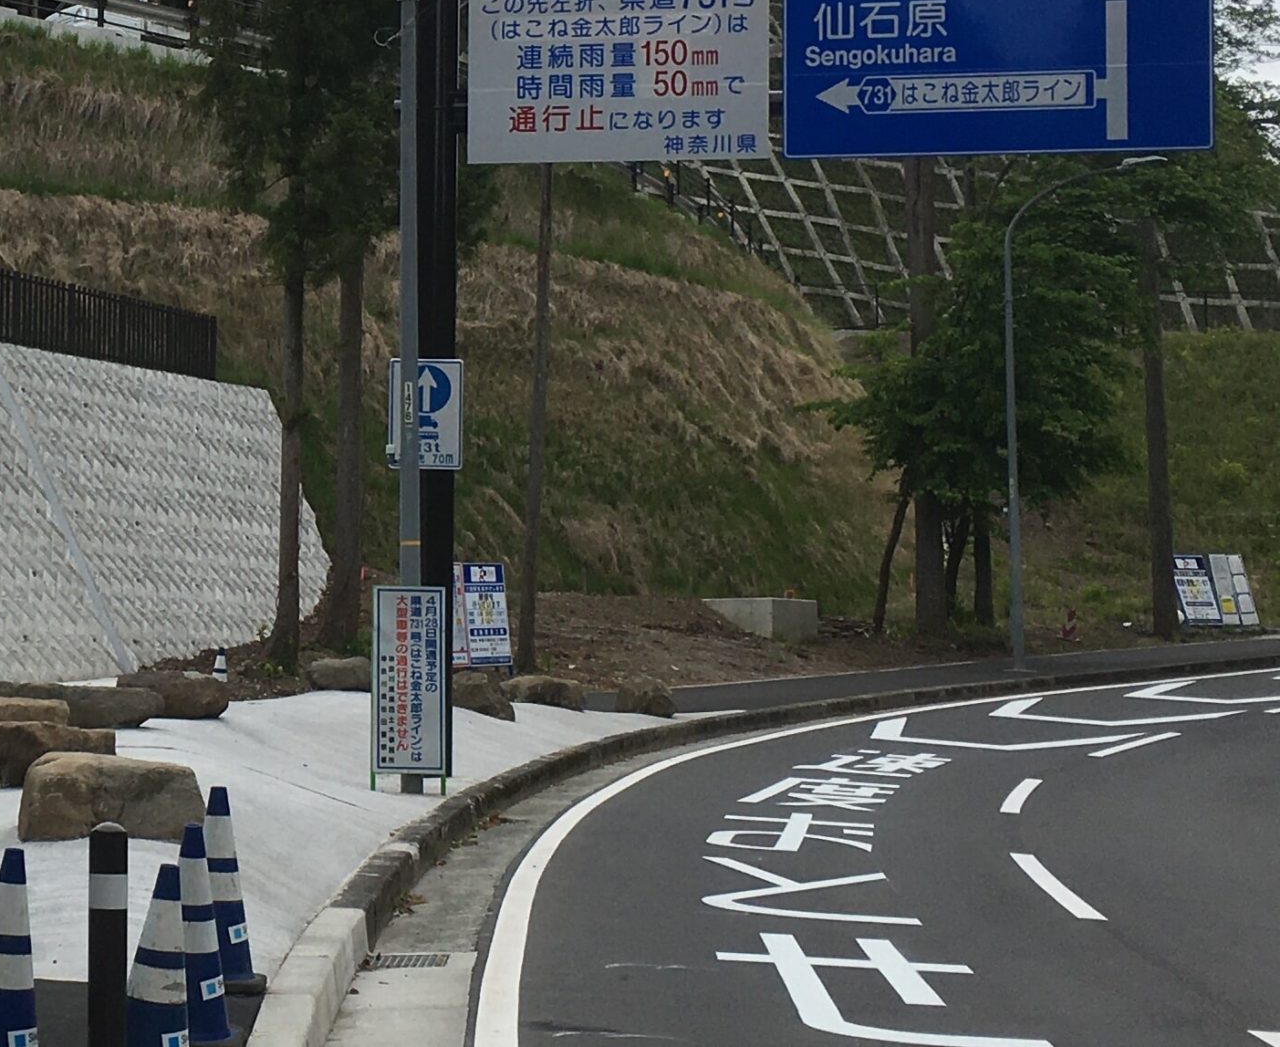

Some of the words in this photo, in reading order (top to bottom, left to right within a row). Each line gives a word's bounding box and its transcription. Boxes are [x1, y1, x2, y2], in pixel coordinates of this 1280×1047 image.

[813, 0, 948, 40] 仙石原
[805, 44, 957, 69] Sengokuhara
[862, 85, 893, 105] 731
[901, 79, 1082, 105] はこね金太郎ライン
[509, 104, 726, 133] 通行止になります
[664, 134, 757, 155] 神奈川県
